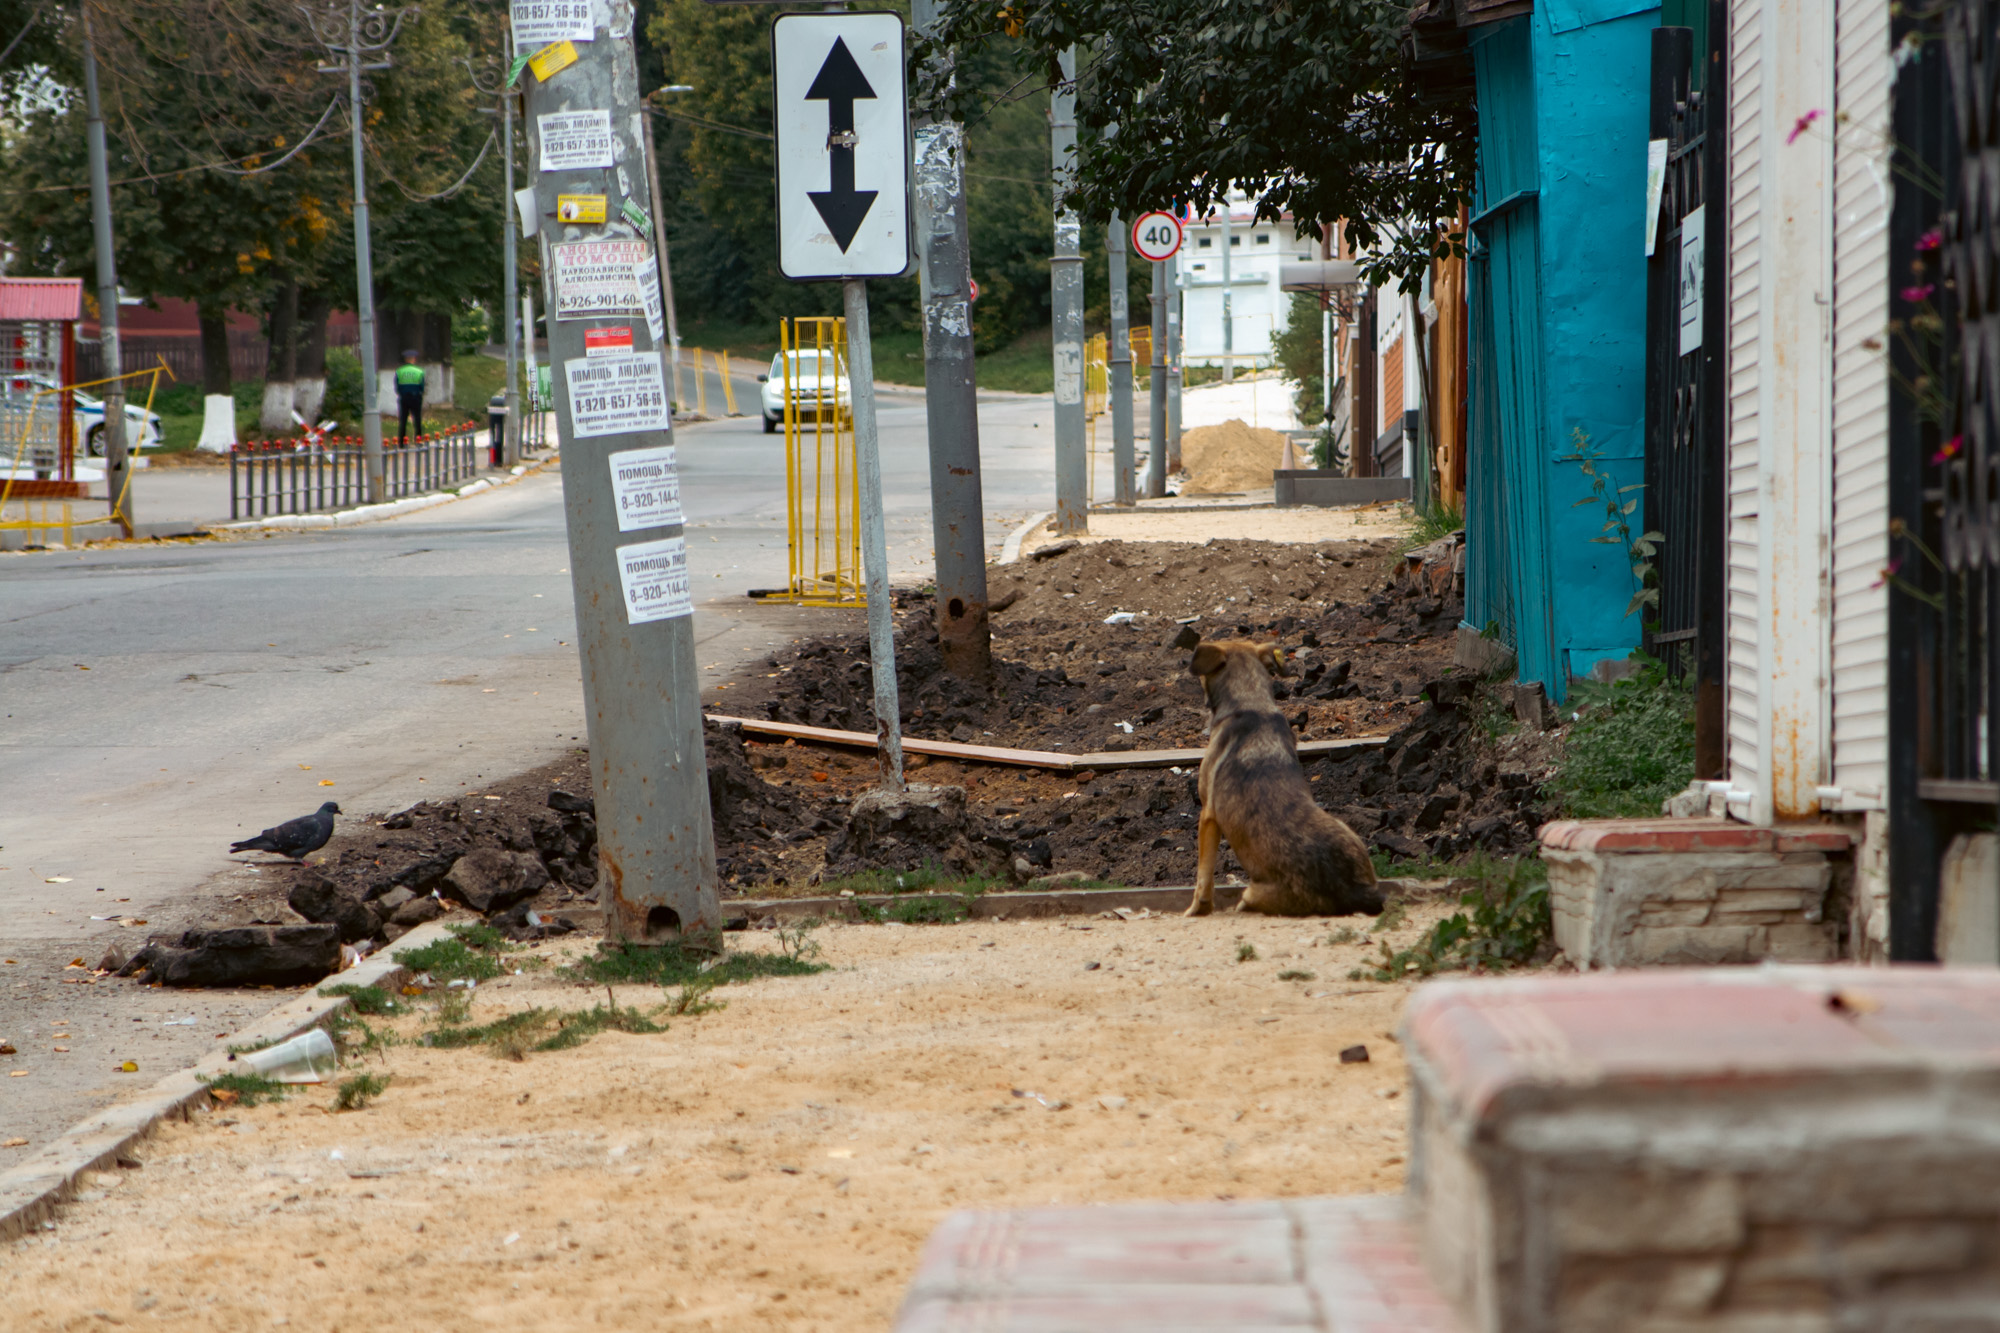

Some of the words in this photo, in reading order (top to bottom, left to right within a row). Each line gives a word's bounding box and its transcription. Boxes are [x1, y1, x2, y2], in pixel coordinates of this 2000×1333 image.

[542, 121, 568, 133] ПОМОЩЬ
[1144, 225, 1171, 246] 40
[559, 242, 645, 257] АНОНИМНАЯ
[563, 253, 644, 267] ПОМОЩЬ
[571, 367, 612, 383] ПОМОЩЬ
[618, 363, 658, 378] ЛЮДЯМ!!!
[575, 392, 661, 414] 8-920-657-56-66
[618, 465, 662, 481] ПОМОЩЬ
[626, 557, 670, 575] ПОМОЩЬ
